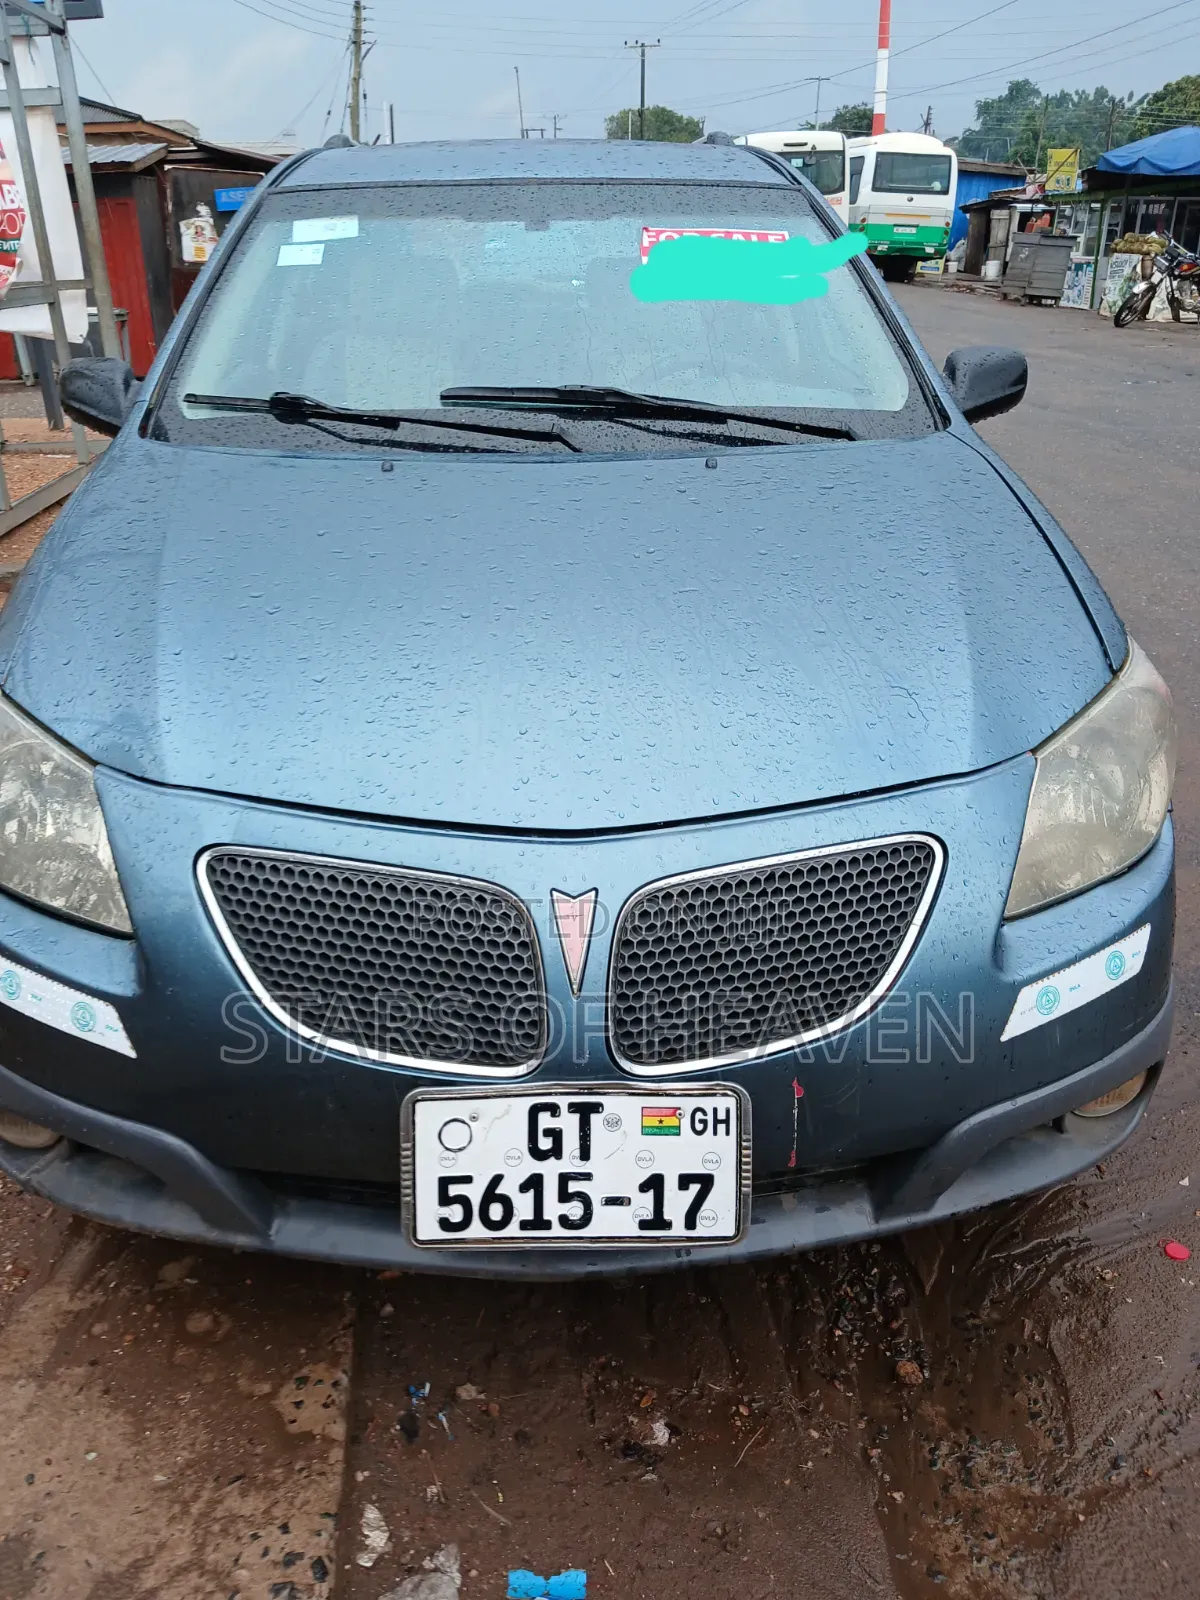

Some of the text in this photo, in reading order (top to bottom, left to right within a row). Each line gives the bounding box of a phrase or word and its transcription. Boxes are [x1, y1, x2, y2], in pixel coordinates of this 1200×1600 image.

[641, 231, 700, 247] FO
[528, 1101, 604, 1162] GT
[690, 1106, 731, 1137] GH
[438, 1171, 715, 1233] 5615-17
